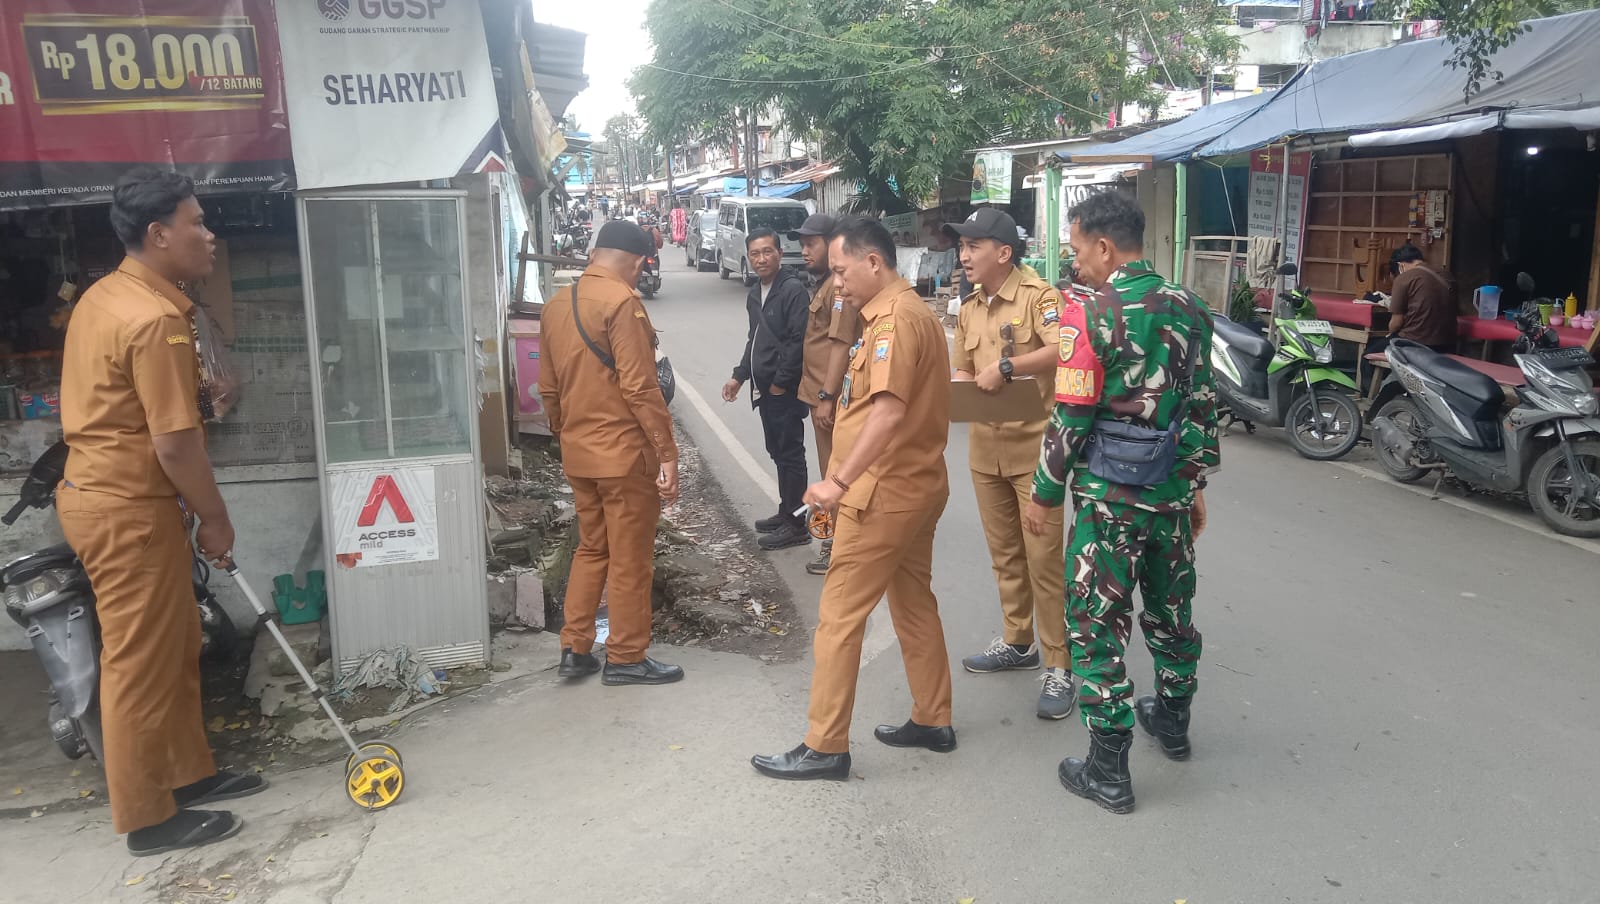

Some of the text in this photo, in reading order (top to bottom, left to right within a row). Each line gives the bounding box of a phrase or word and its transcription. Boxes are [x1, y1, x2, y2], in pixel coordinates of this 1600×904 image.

[359, 0, 447, 20] GGSP
[40, 33, 245, 90] Rp 18.000
[223, 77, 263, 90] BATANG
[323, 70, 467, 106] SEHARYATI
[19, 188, 56, 197] MEMBERI
[58, 186, 90, 195] KEPADA
[210, 177, 254, 185] PEREMPUAN
[358, 529, 416, 541] ACCESS
[360, 541, 383, 550] mild
